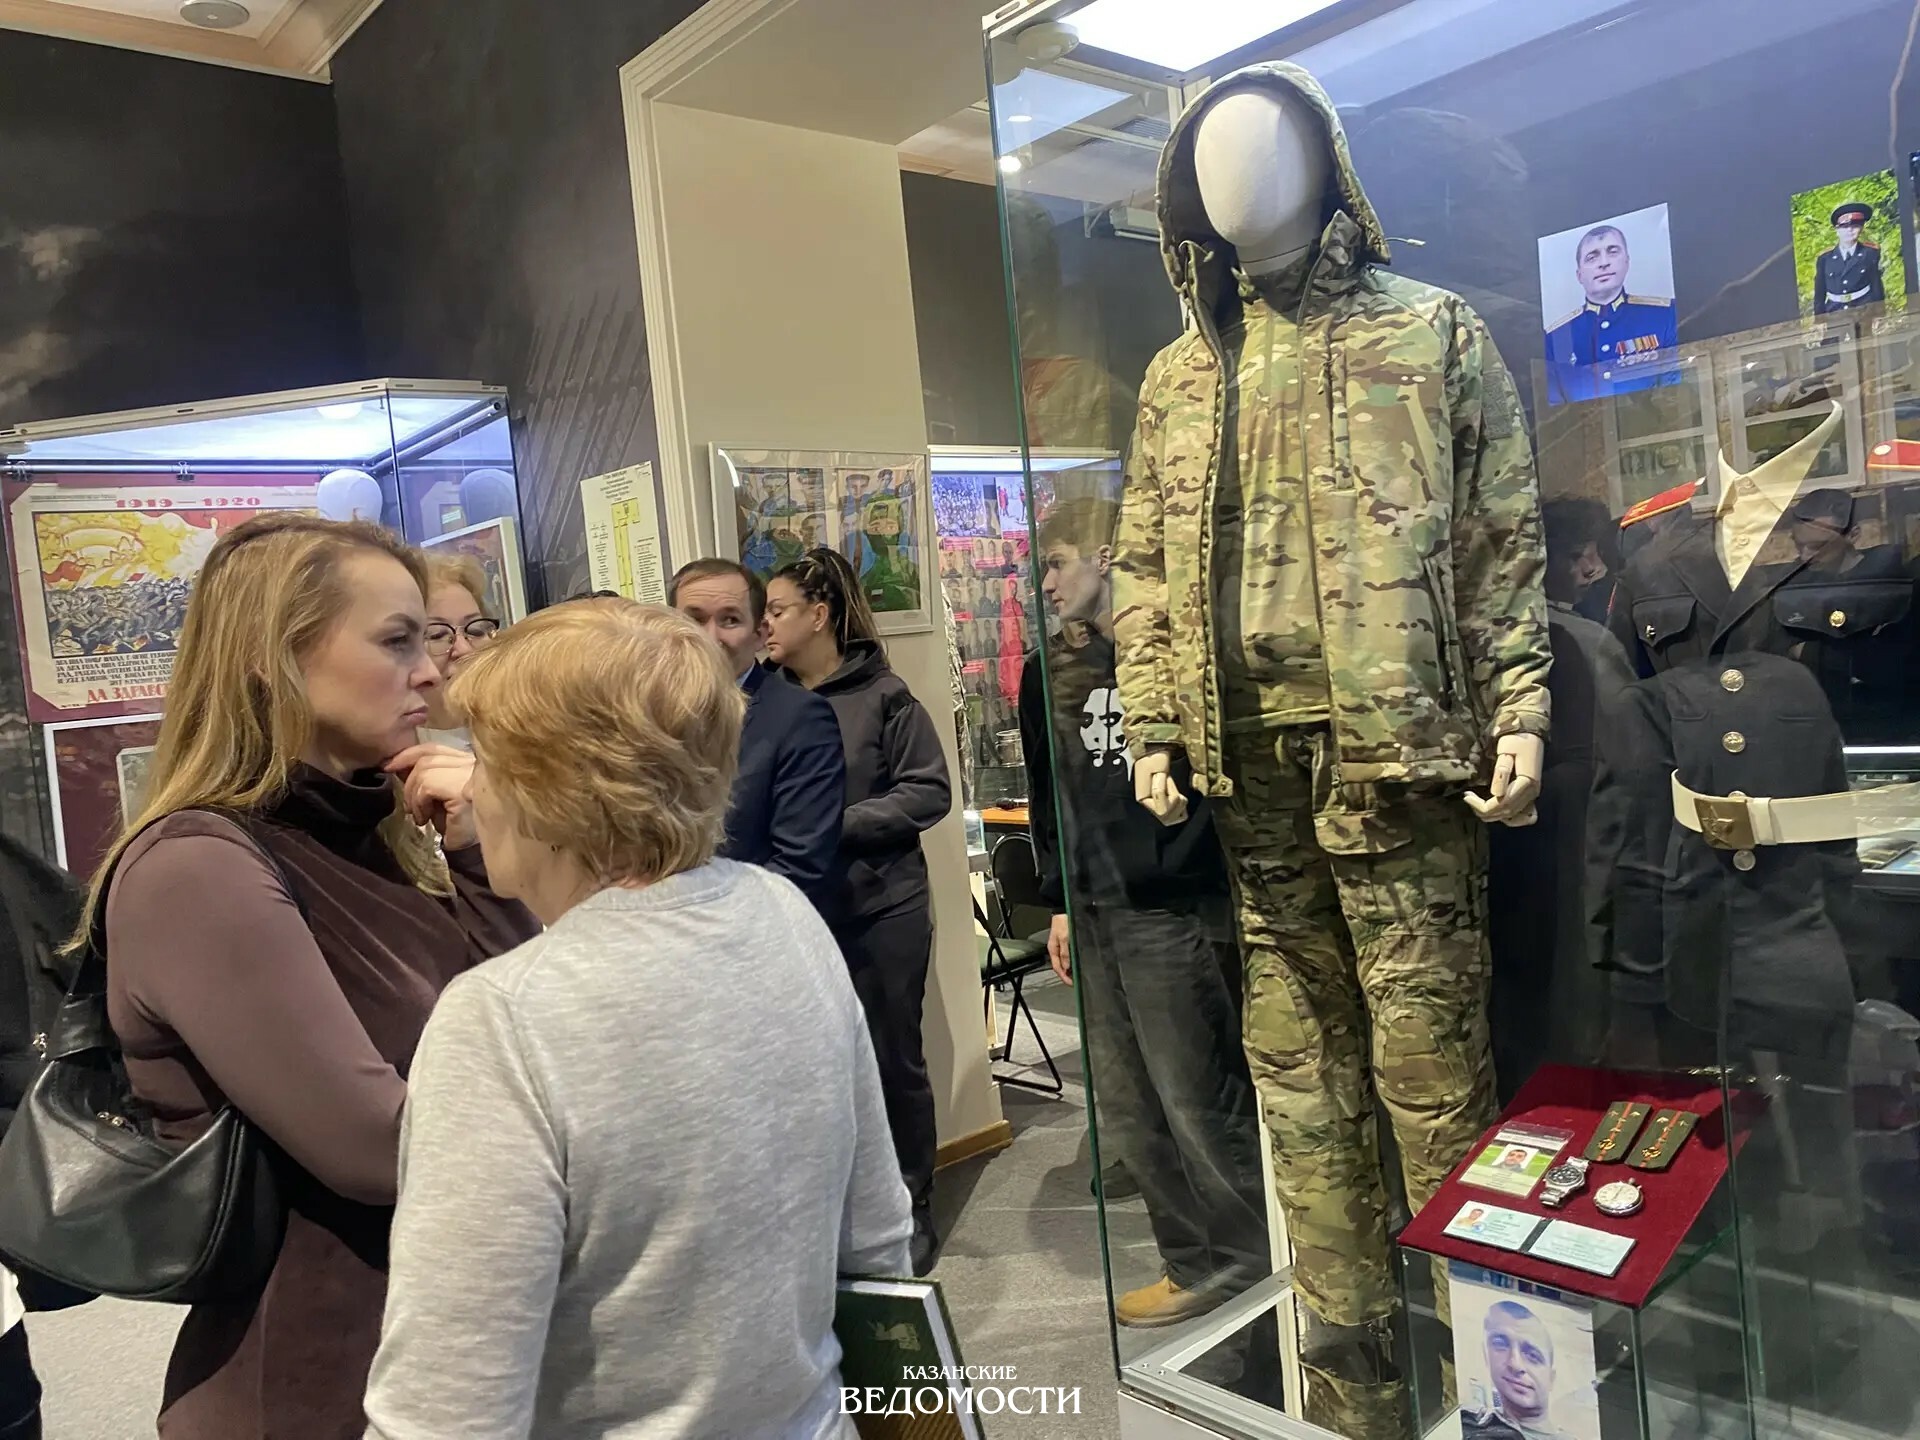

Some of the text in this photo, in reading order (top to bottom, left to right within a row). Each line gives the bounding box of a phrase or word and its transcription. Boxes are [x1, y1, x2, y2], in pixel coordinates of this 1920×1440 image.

[116, 498, 173, 508] 1919
[202, 497, 261, 506] 1920
[88, 689, 108, 702] ДА
